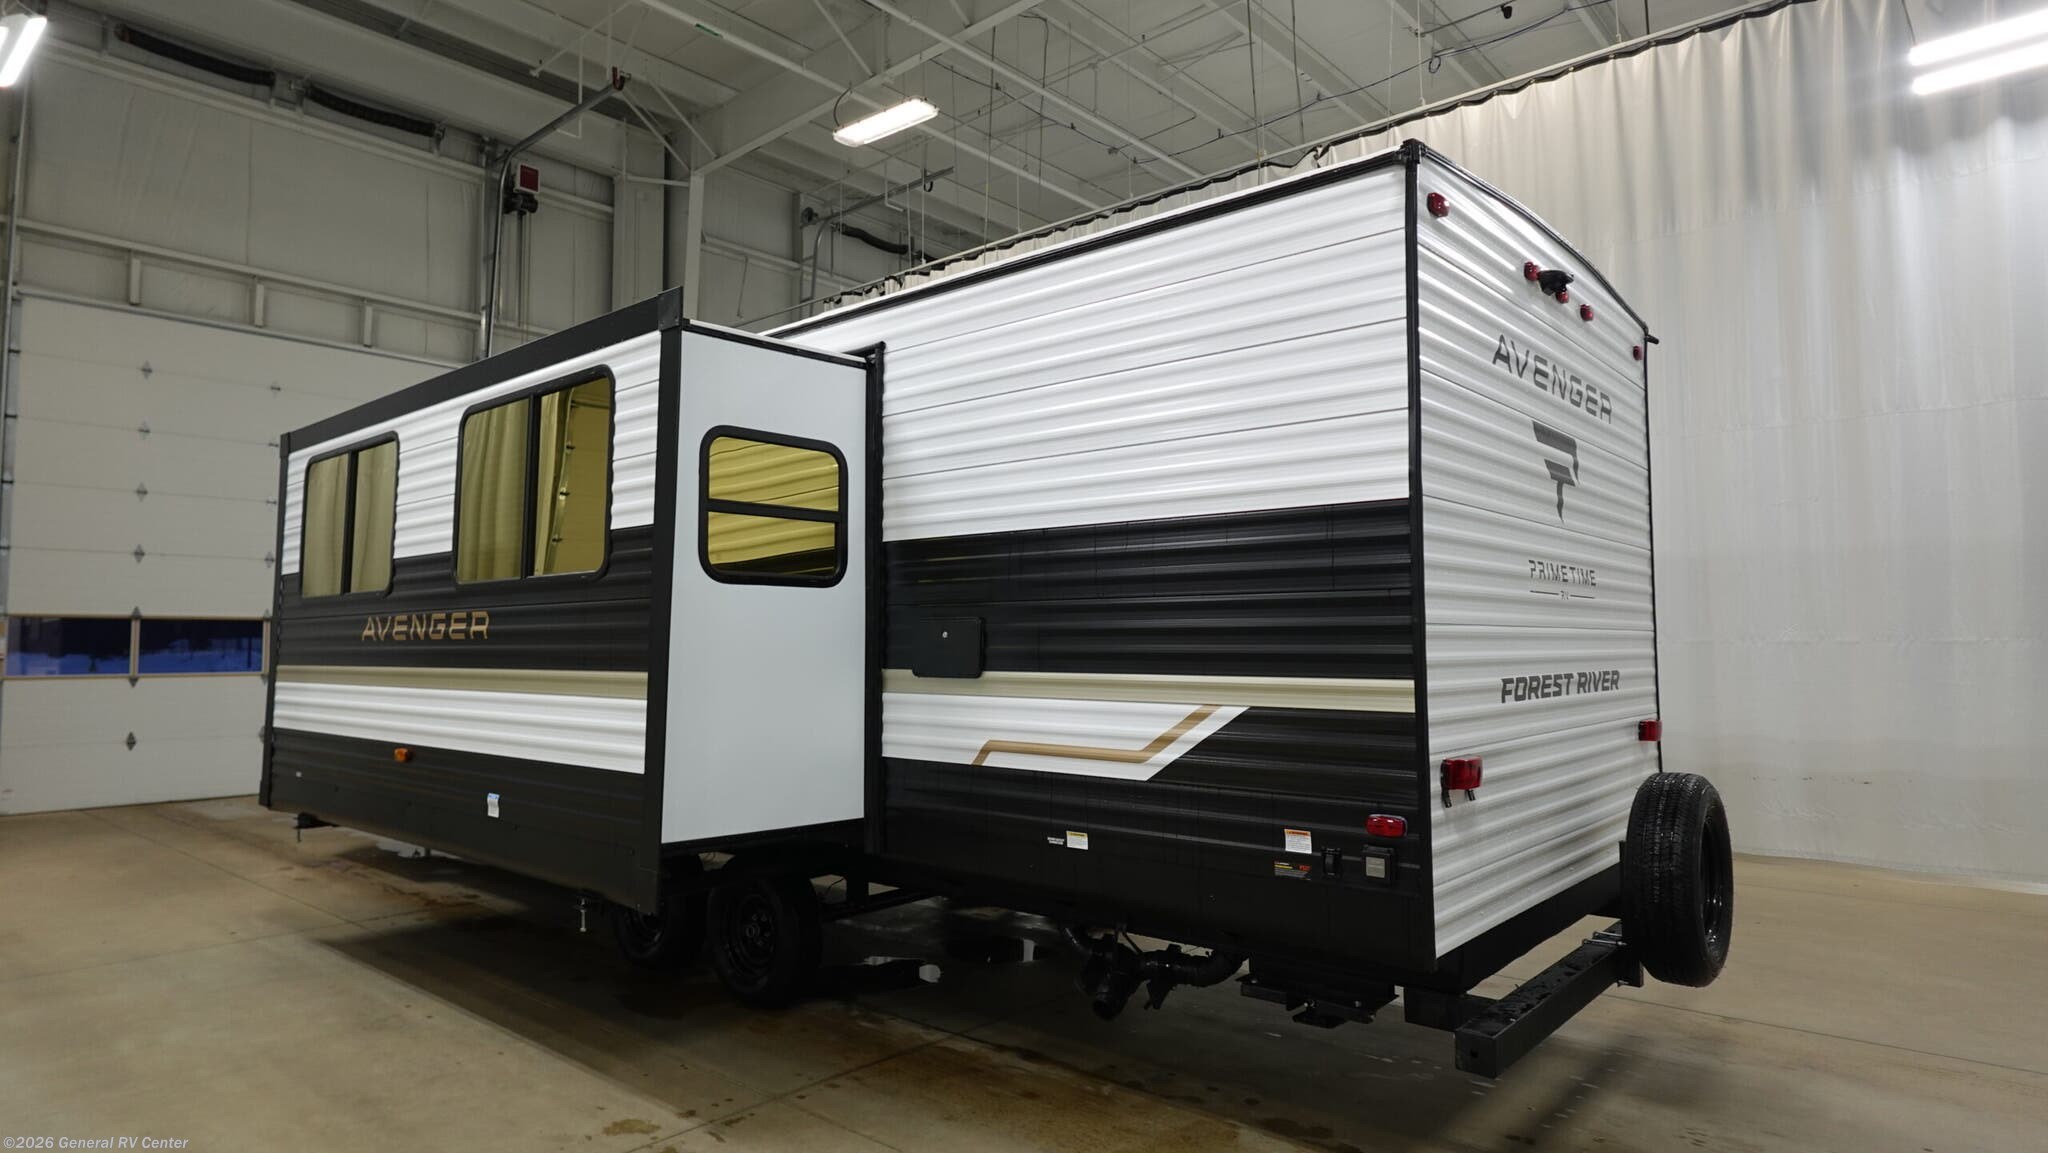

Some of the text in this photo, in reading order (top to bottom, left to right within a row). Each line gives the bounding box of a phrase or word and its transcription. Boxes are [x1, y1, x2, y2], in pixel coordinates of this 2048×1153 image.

[1492, 334, 1612, 424] AVENGER
[361, 610, 490, 641] AVENGER
[1500, 670, 1620, 704] FOREST RIVER
